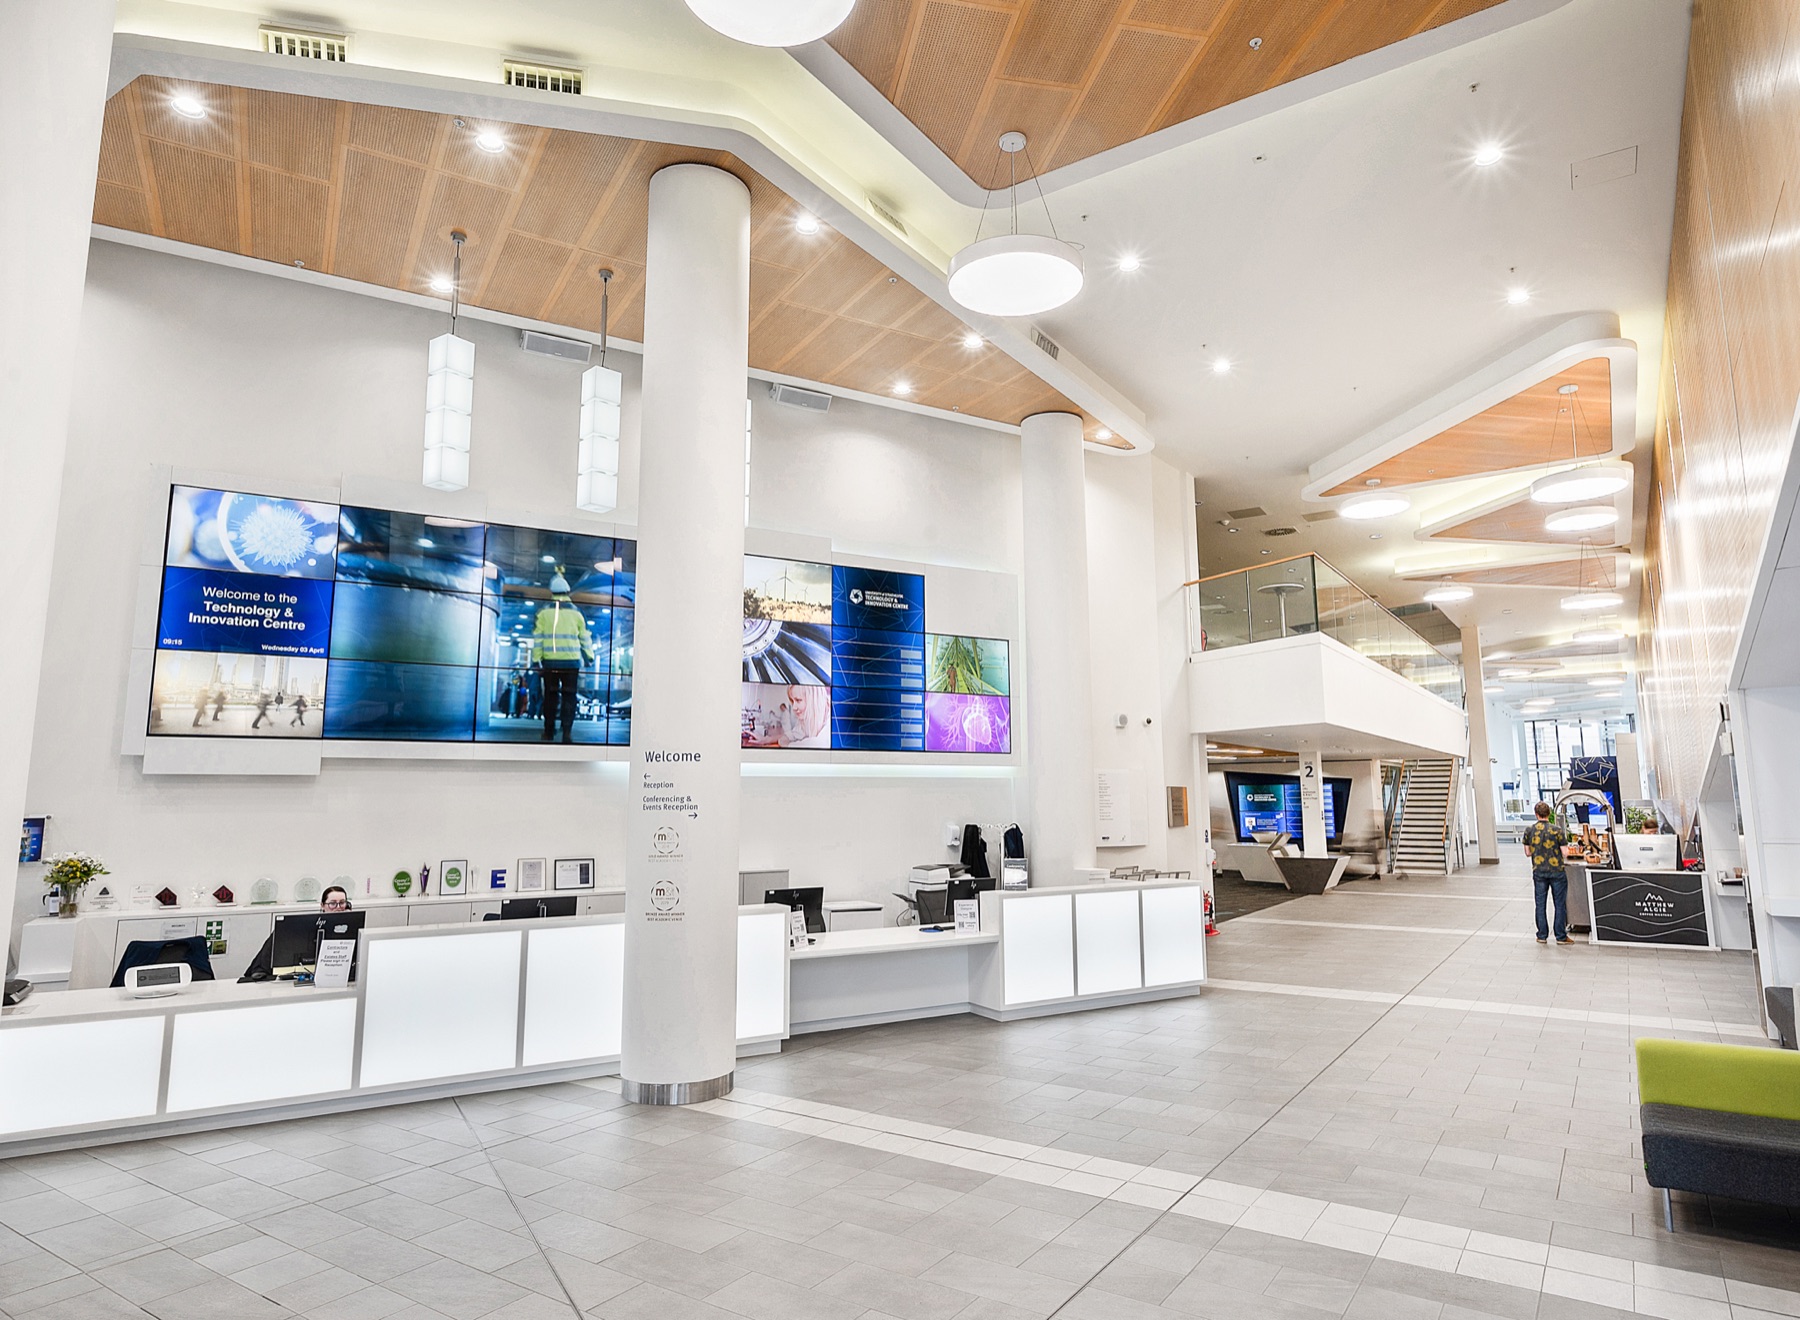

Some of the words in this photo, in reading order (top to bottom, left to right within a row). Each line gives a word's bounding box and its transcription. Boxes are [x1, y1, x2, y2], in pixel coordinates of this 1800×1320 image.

[202, 586, 260, 601] Welcome
[264, 592, 276, 603] to
[278, 593, 298, 604] the
[865, 600, 892, 608] INNOVATION
[204, 601, 280, 619] Technology
[284, 608, 294, 617] &
[188, 613, 259, 628] Innovation
[263, 618, 306, 631] Centre
[163, 638, 182, 646] 09:15
[261, 644, 298, 653] Wednesday
[645, 750, 701, 762] Welcome
[1305, 766, 1314, 778] 2
[643, 781, 674, 789] Reception
[642, 795, 684, 803] Conferencing
[663, 803, 699, 812] Reception
[490, 869, 507, 888] E
